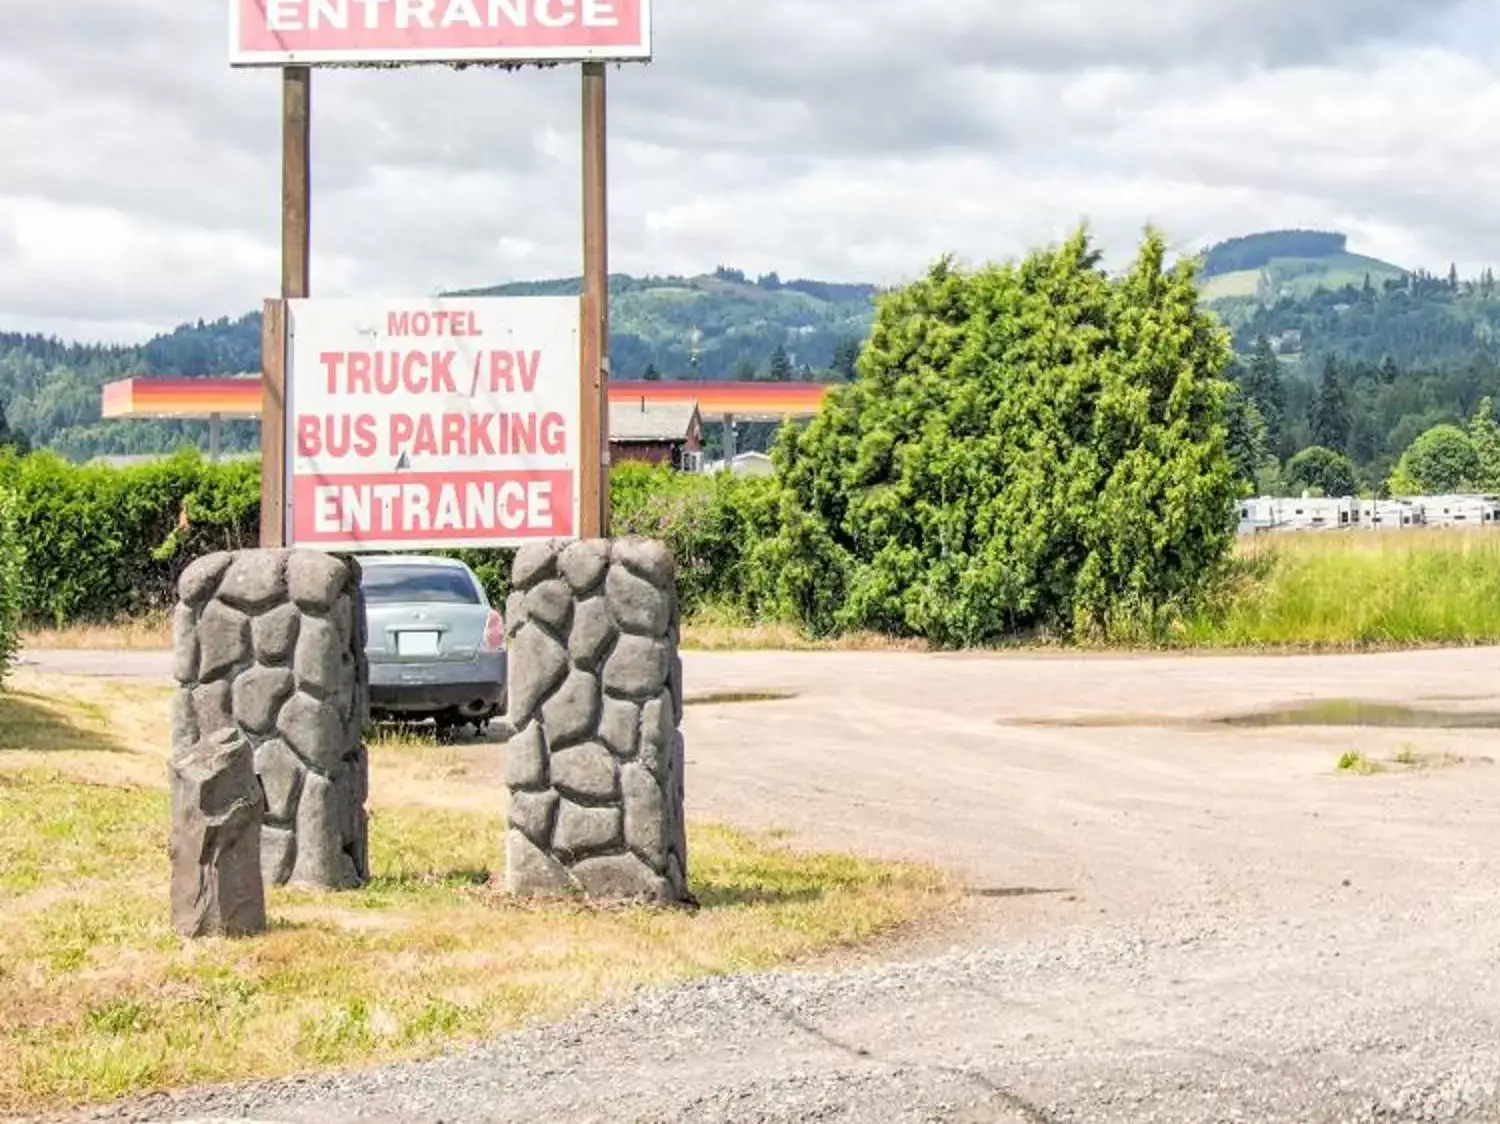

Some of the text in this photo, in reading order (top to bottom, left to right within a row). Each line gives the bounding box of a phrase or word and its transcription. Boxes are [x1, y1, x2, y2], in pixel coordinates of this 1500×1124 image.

[387, 311, 483, 337] MOTEL
[297, 412, 567, 458] BUS PARKING
[313, 481, 553, 534] ENTRANCE
